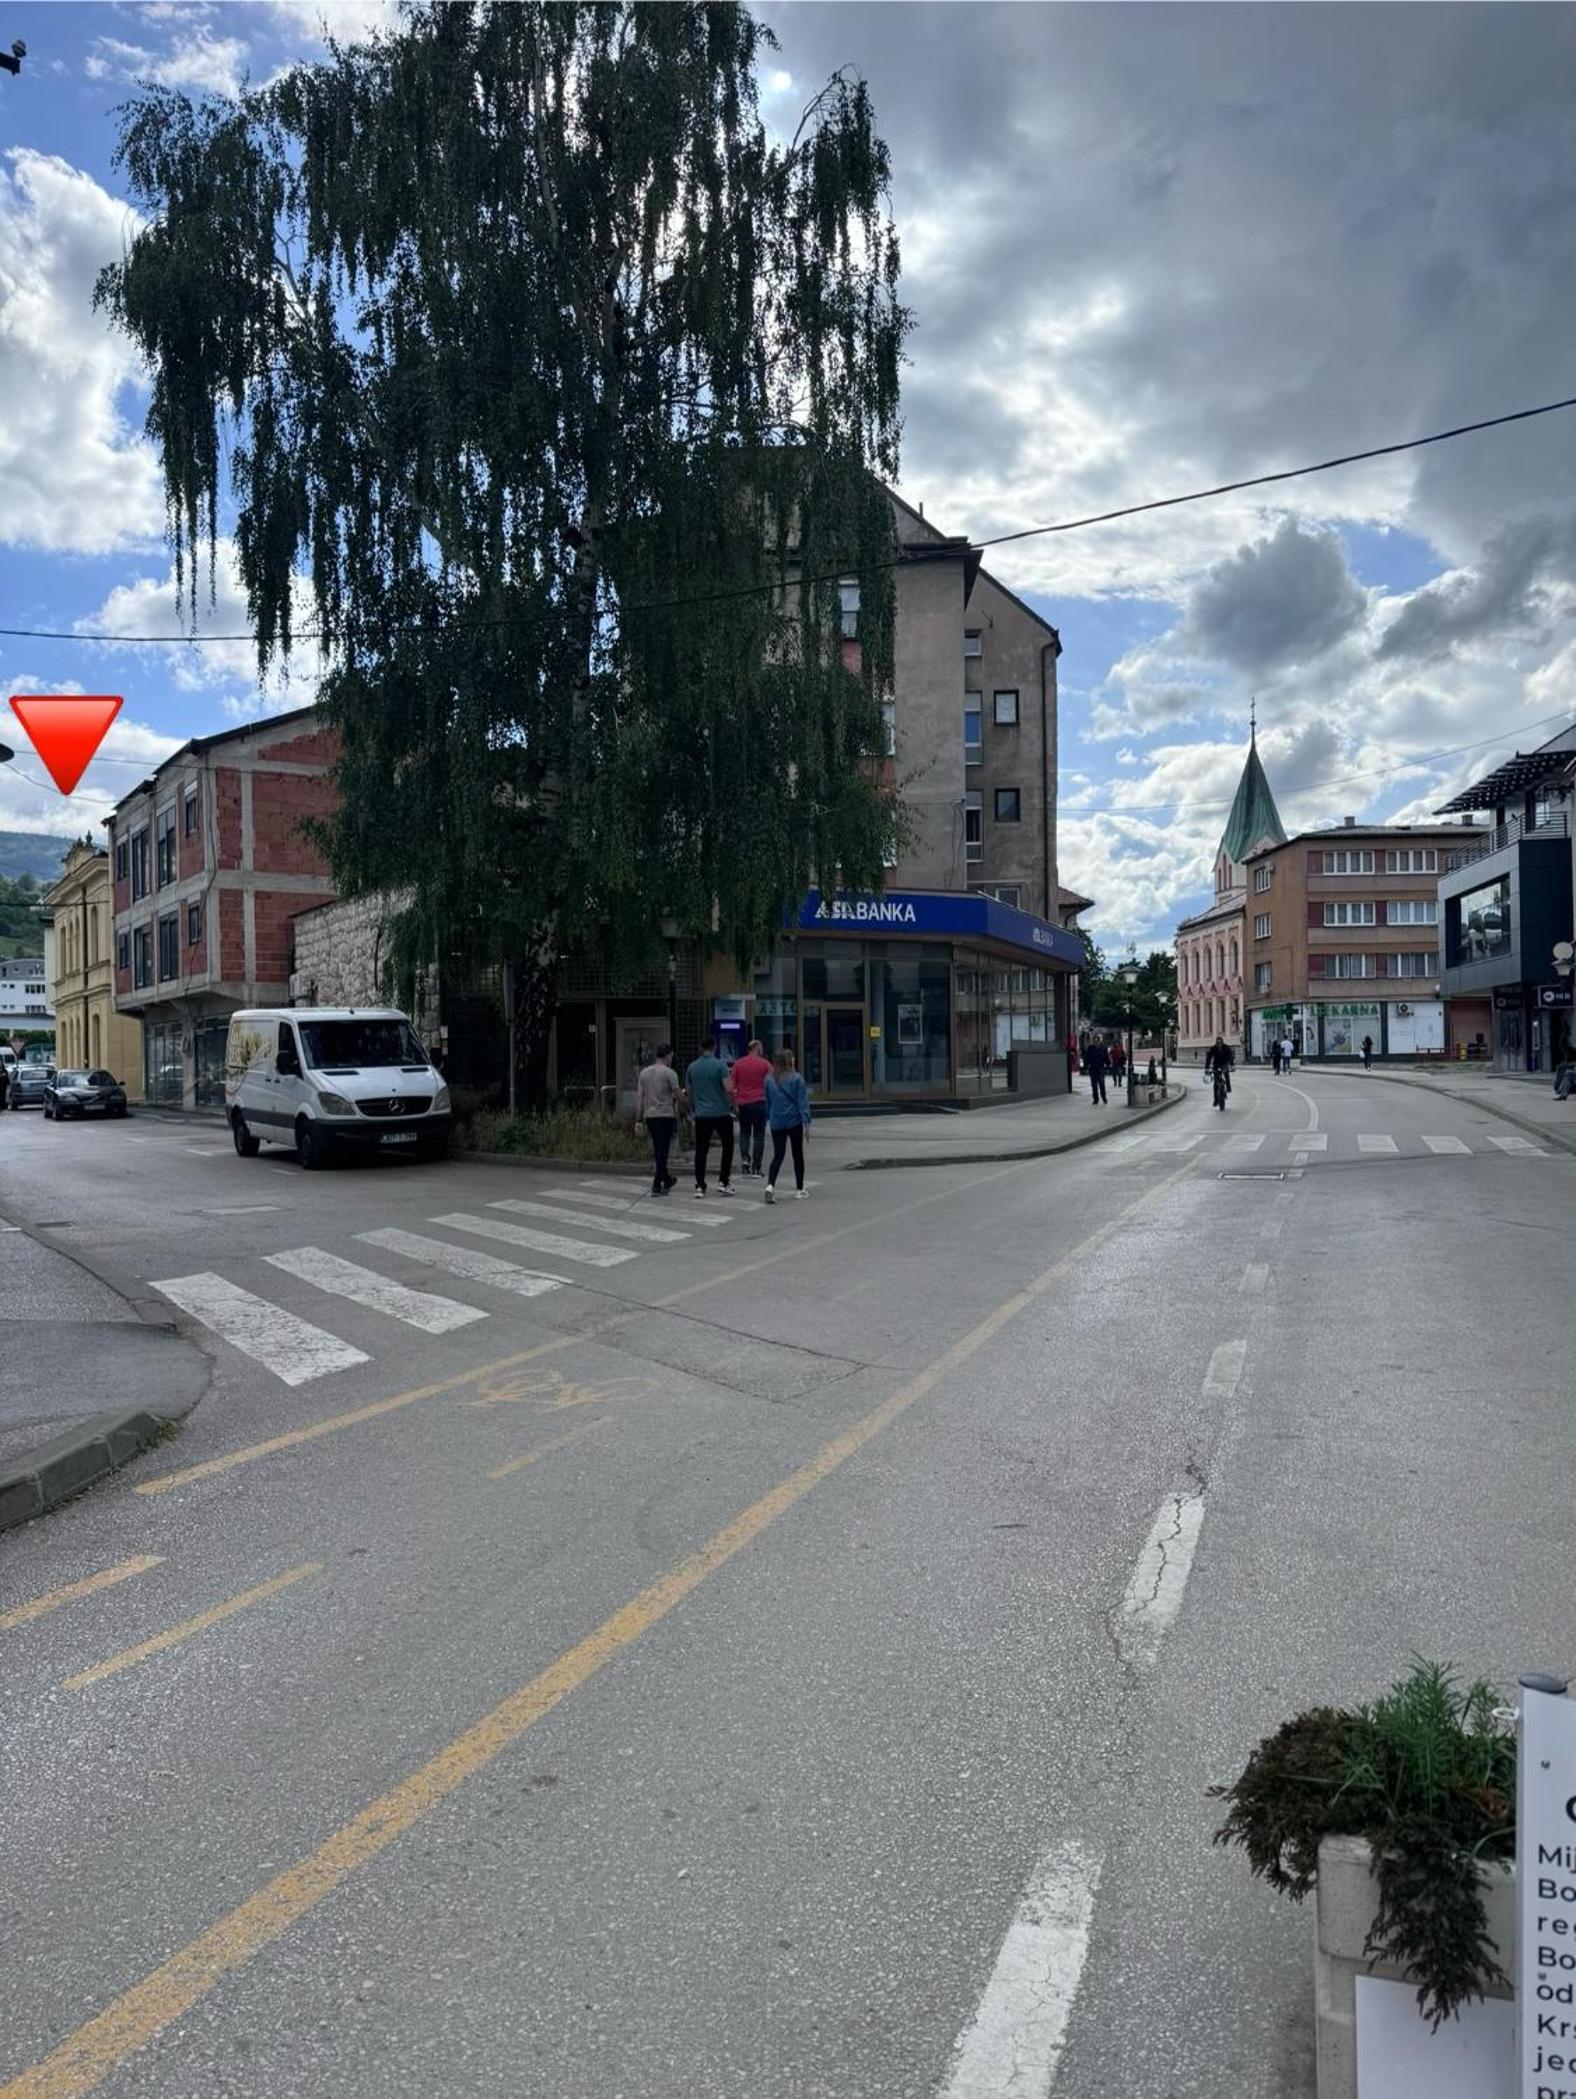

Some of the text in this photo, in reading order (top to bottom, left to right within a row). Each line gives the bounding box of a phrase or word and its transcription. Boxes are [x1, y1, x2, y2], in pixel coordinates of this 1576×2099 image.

[1538, 1916, 1576, 1936] re
[1536, 1983, 1573, 2004] od
[1537, 2013, 1576, 2038] Kr
